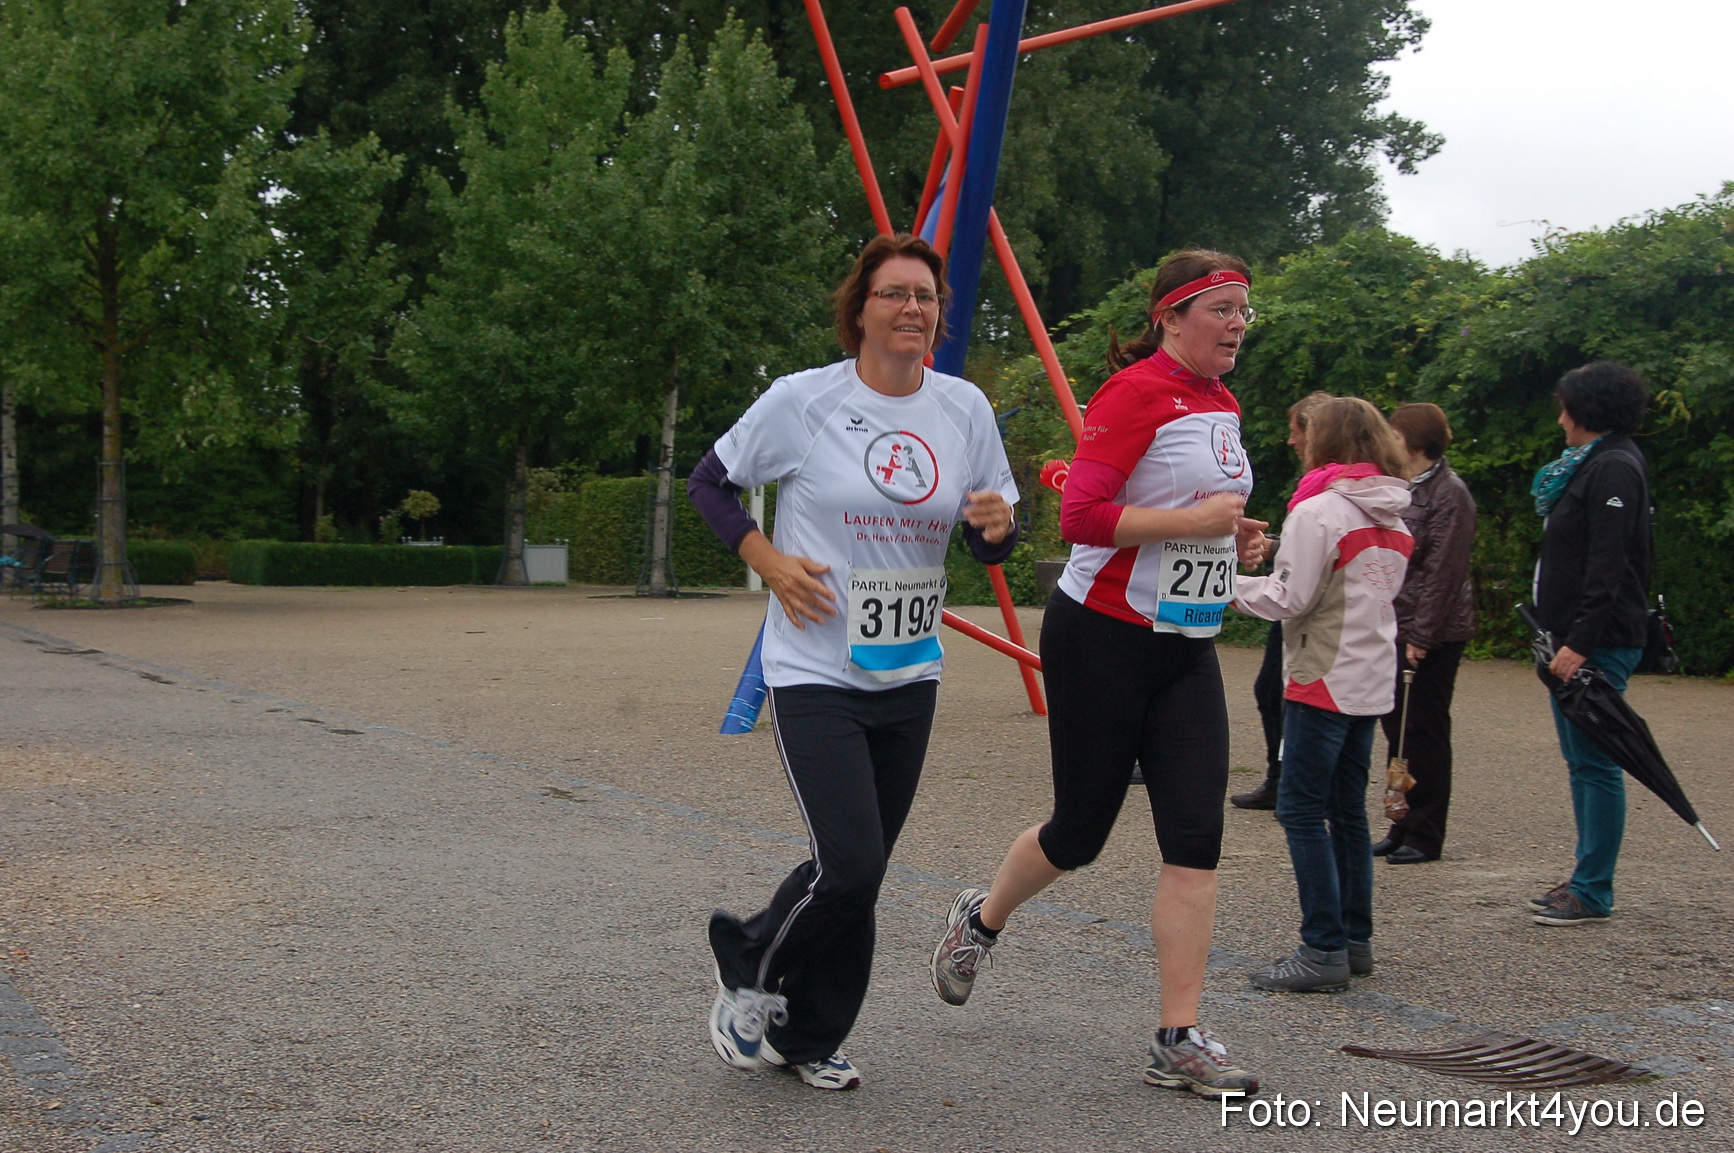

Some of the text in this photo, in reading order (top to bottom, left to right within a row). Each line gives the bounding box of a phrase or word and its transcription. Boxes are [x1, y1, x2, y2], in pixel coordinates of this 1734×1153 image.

[844, 511, 895, 527] LAUFEN
[900, 518, 923, 529] MIT
[1164, 542, 1201, 555] PARTL
[851, 579, 938, 592] PARTL Neumarkt
[1169, 558, 1234, 598] 2731
[860, 595, 939, 639] 3193
